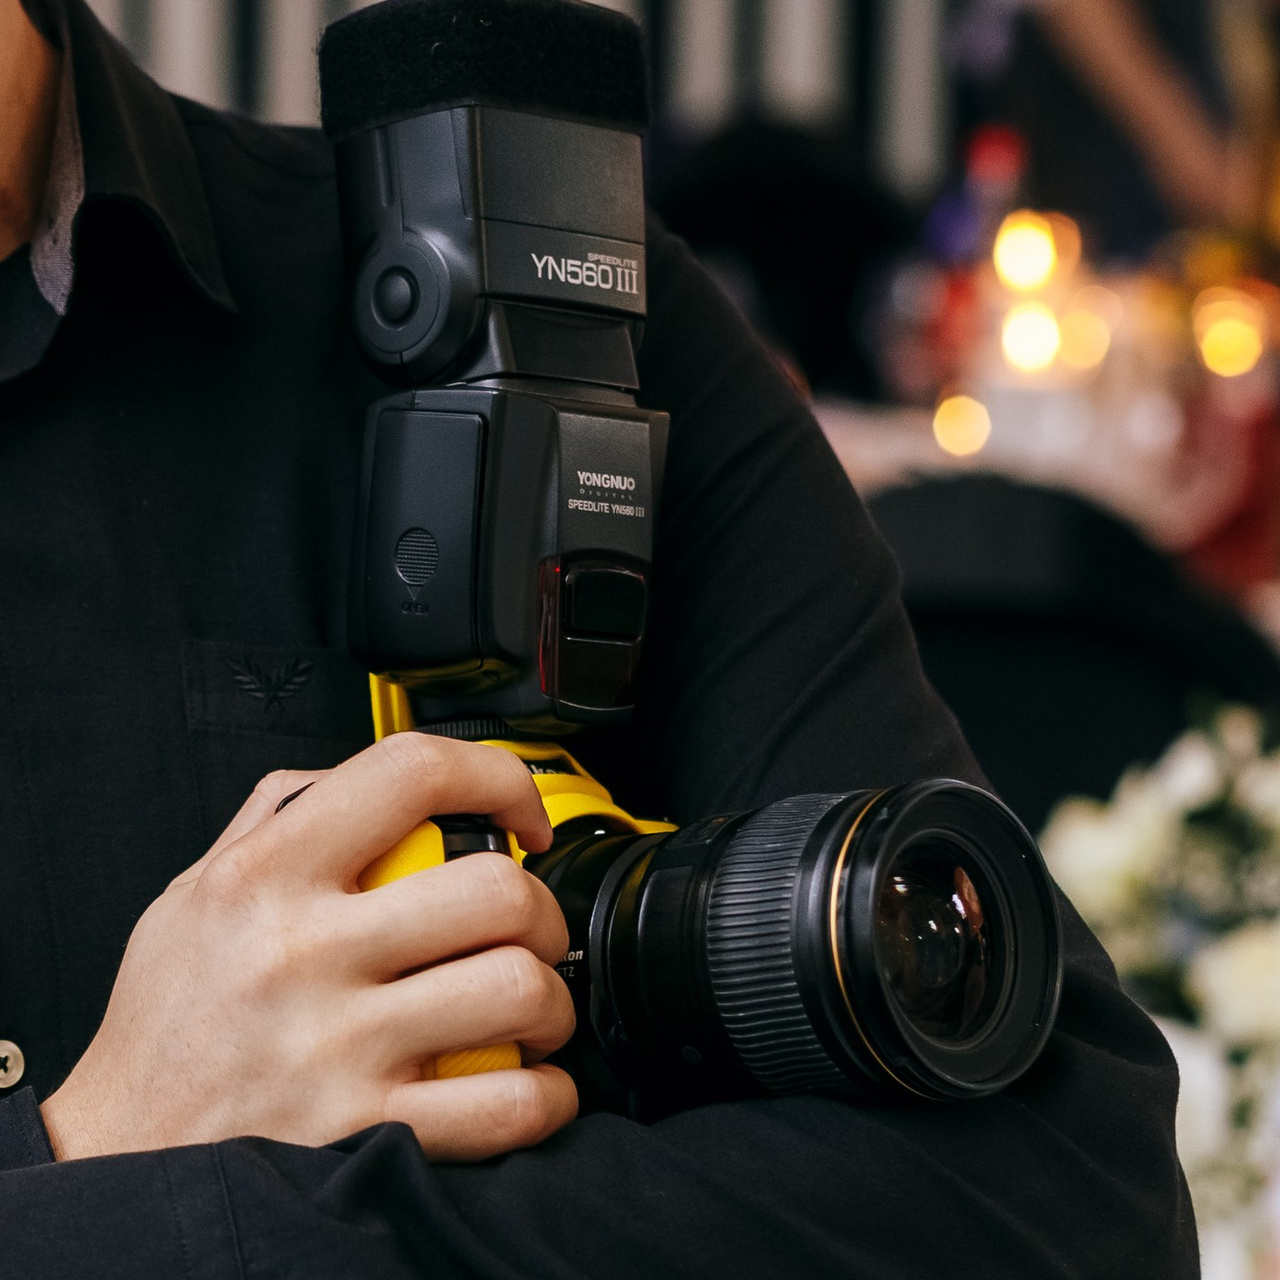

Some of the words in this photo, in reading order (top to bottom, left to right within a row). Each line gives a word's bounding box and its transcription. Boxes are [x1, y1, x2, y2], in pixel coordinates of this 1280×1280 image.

[588, 253, 638, 269] SPEEDLITE
[577, 470, 635, 491] YONGNUO
[568, 498, 610, 514] SPEEDLITE
